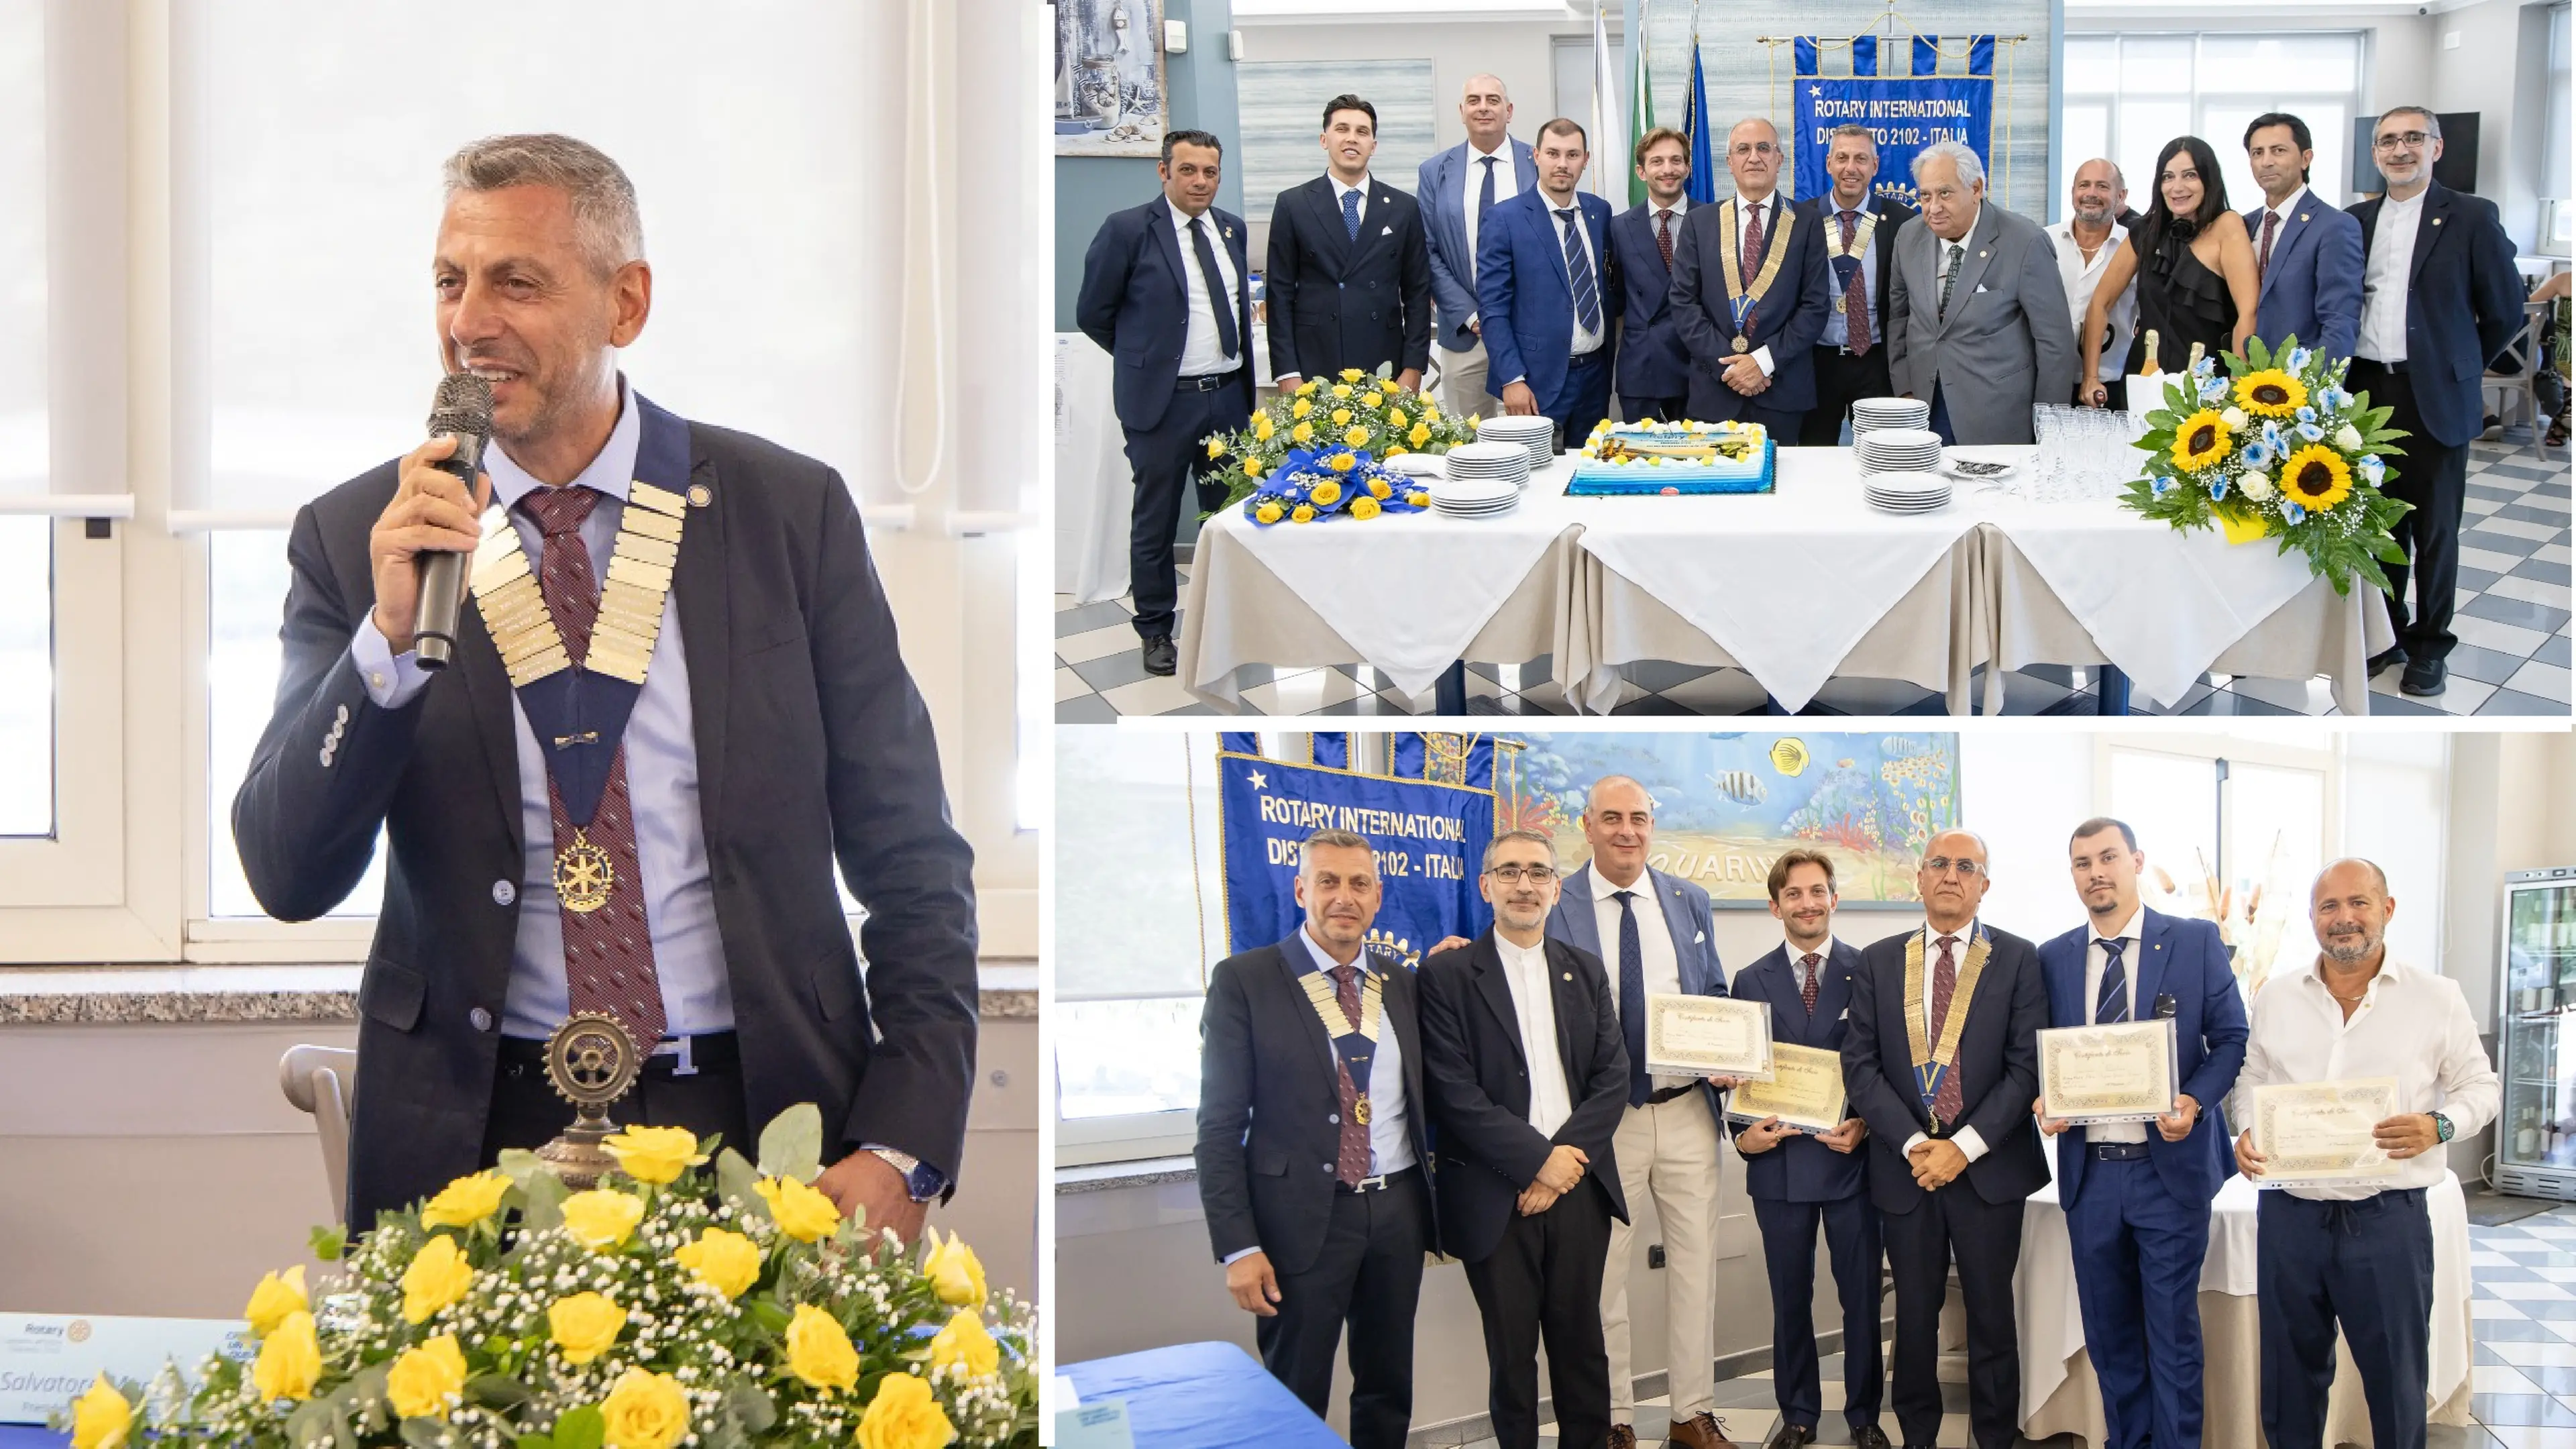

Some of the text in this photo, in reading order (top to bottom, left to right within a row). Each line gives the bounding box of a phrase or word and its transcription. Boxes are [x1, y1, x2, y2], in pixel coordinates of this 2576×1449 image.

[1815, 100, 1971, 118] ROTARY INTERNATIONAL
[1890, 127, 1919, 145] 2102
[1878, 193, 1908, 203] TARY
[1260, 795, 1466, 843] ROTARY INTERNATIONAL
[1426, 853, 1464, 880] ITALIA
[1365, 945, 1399, 960] TARY
[25, 1323, 64, 1338] Rotary
